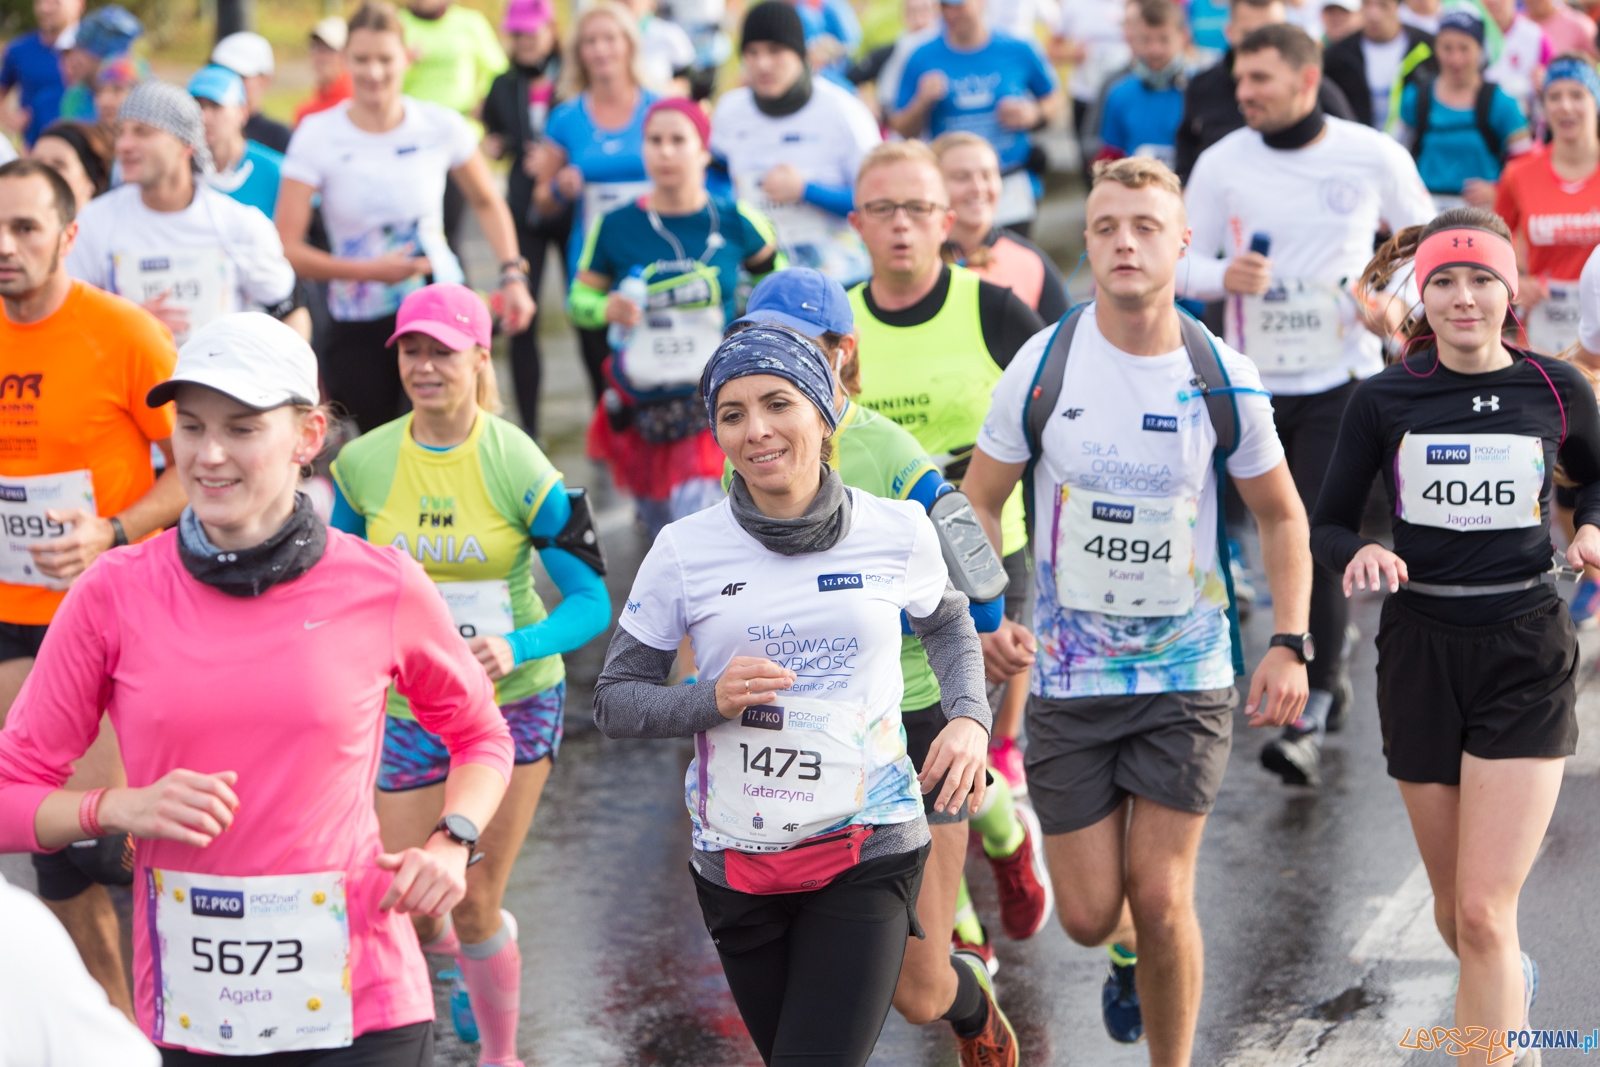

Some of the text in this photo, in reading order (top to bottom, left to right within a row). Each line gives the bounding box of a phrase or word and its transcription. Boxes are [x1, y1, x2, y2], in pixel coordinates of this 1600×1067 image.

[861, 394, 930, 411] NNING
[1081, 440, 1119, 457] SIŁA
[1091, 459, 1172, 478] ODWAGA
[1422, 480, 1516, 506] 4046
[1444, 513, 1492, 527] Jagoda
[391, 533, 488, 564] ANIA
[1084, 534, 1172, 563] 4894
[1108, 569, 1144, 581] Kamil
[720, 582, 747, 596] 4F
[747, 622, 795, 642] SIŁA
[765, 637, 859, 657] ODWAGA
[772, 652, 857, 671] YBKOŚĆ
[739, 742, 822, 781] 1473
[743, 782, 815, 803] Katarzyna
[191, 936, 304, 976] 5673
[219, 986, 273, 1005] Agata
